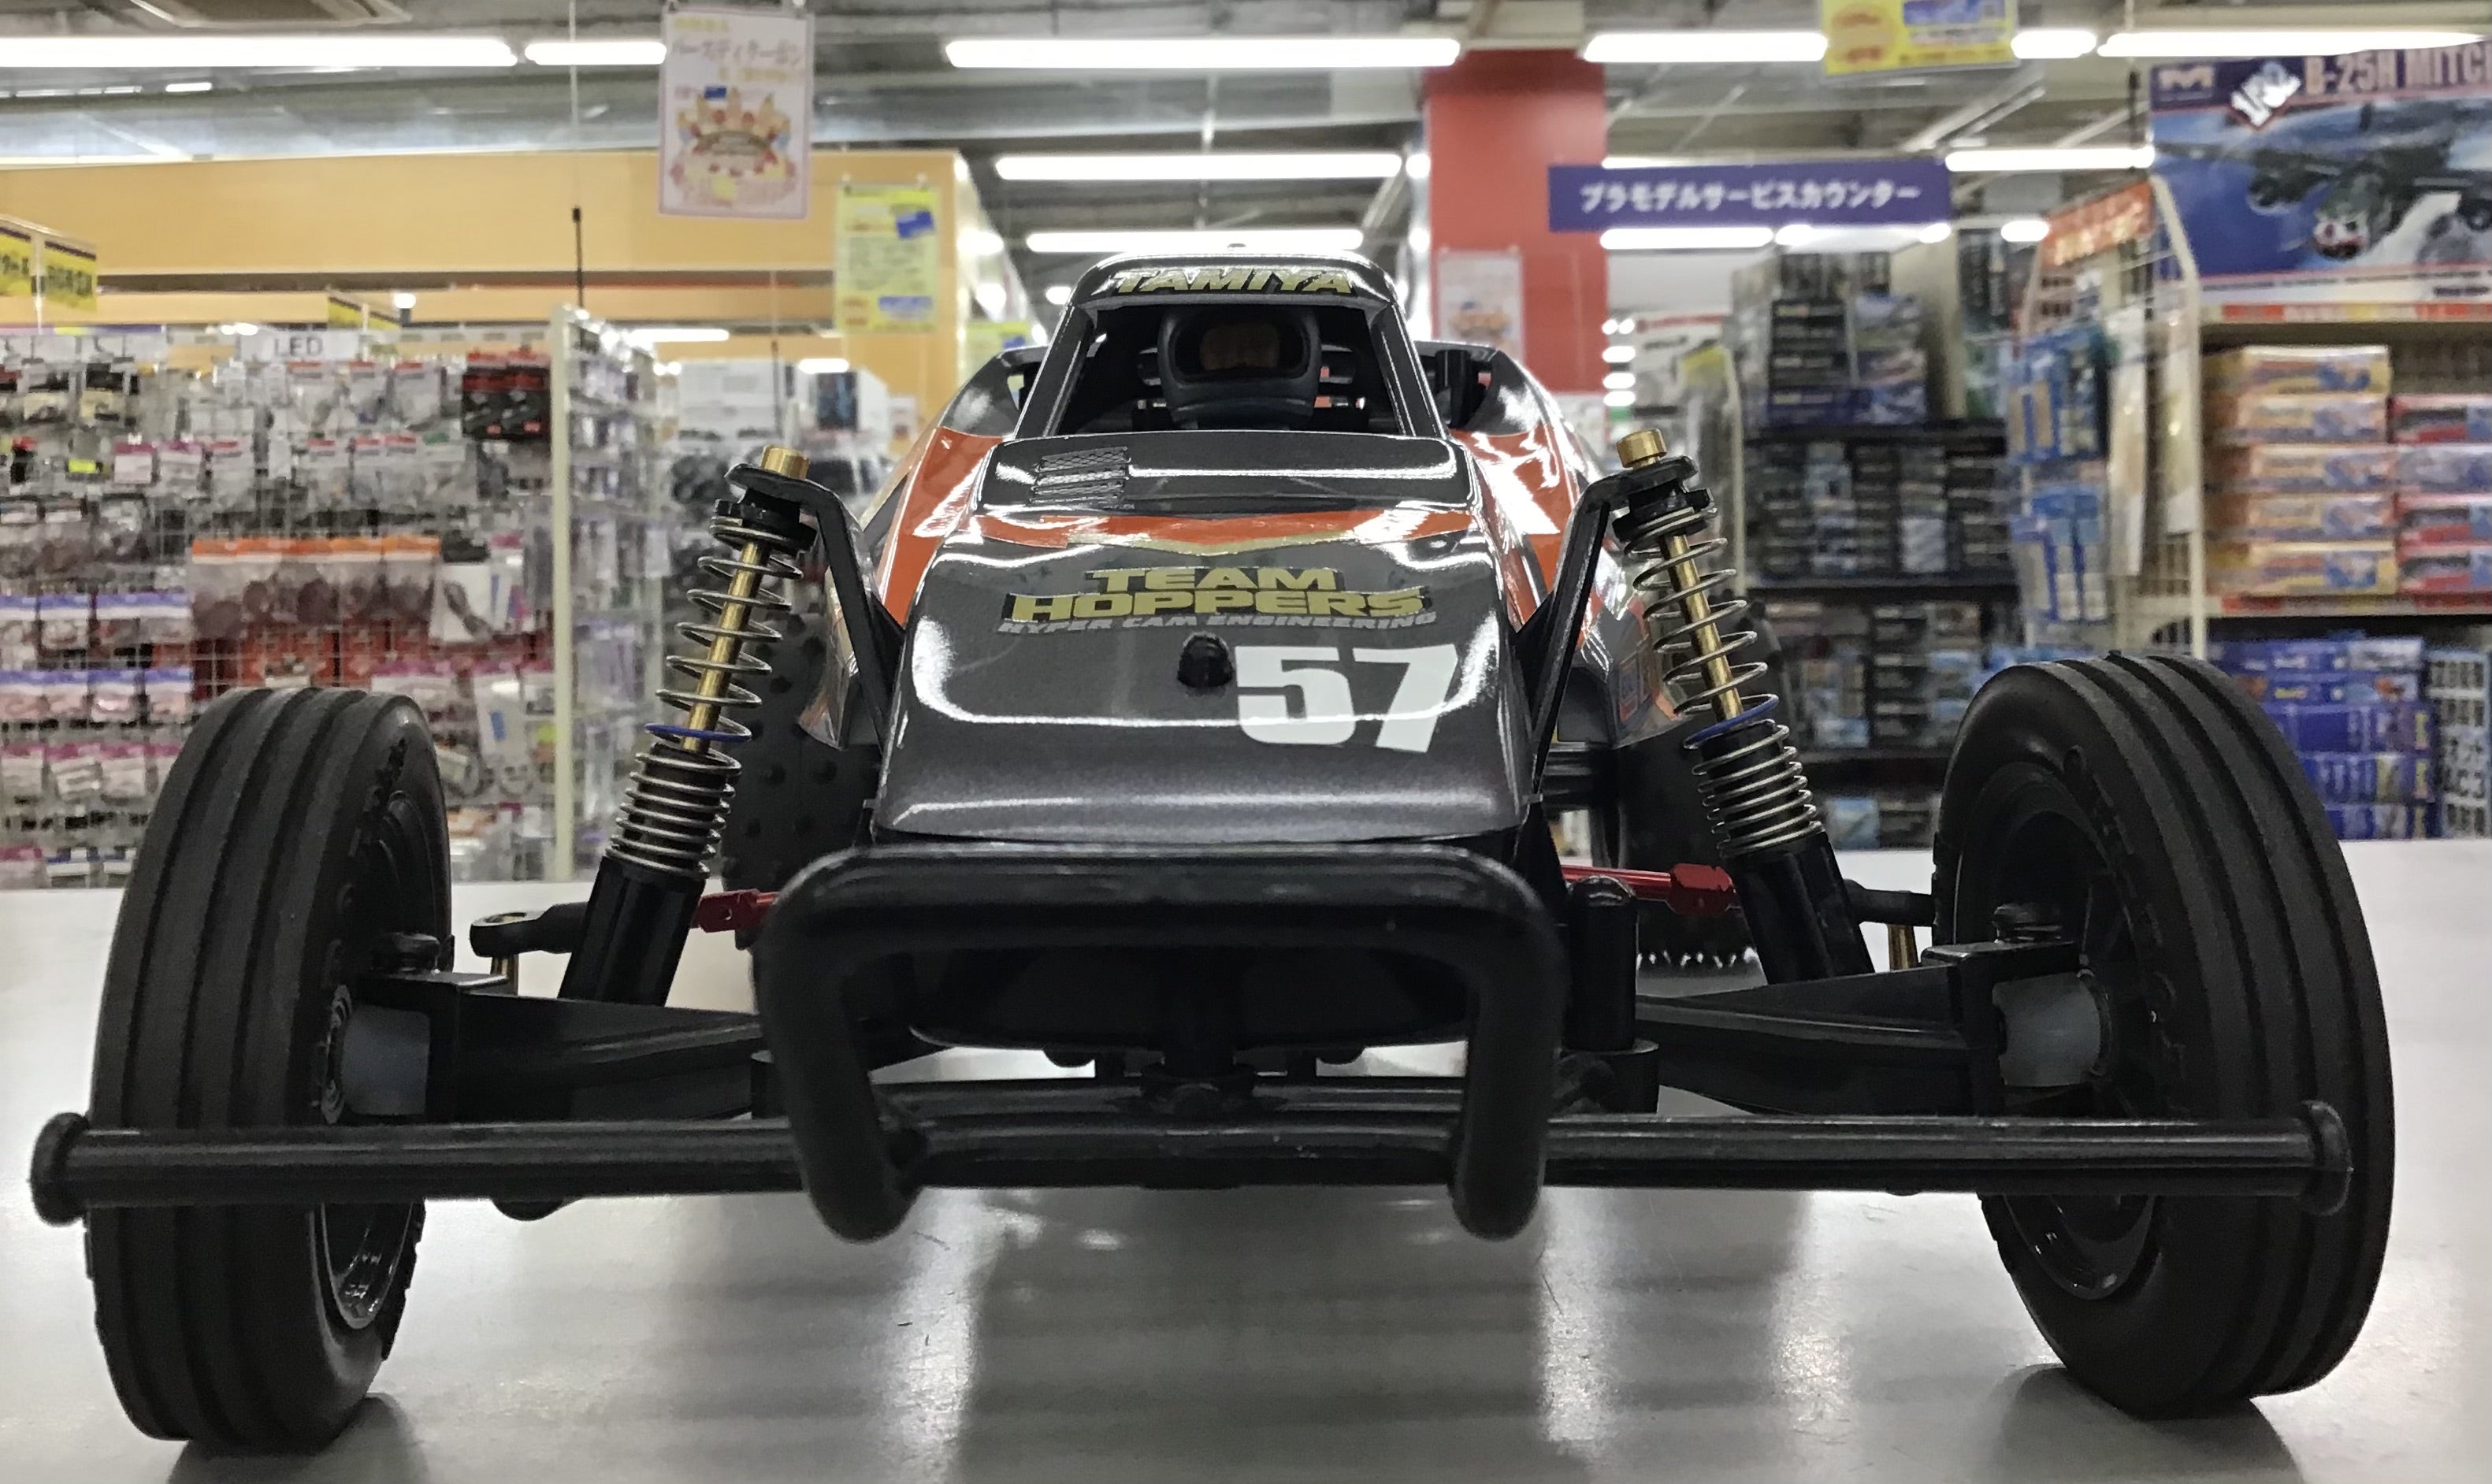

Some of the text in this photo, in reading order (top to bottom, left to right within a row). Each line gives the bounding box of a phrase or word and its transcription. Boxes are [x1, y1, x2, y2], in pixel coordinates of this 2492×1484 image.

[1113, 266, 1353, 294] TAMIYA
[274, 336, 323, 356] LED
[1093, 567, 1337, 592] TEAM
[1012, 587, 1426, 622] HOPPERS
[997, 611, 1438, 634] HYPER CAM ENGINEERING
[1234, 643, 1458, 754] 57
